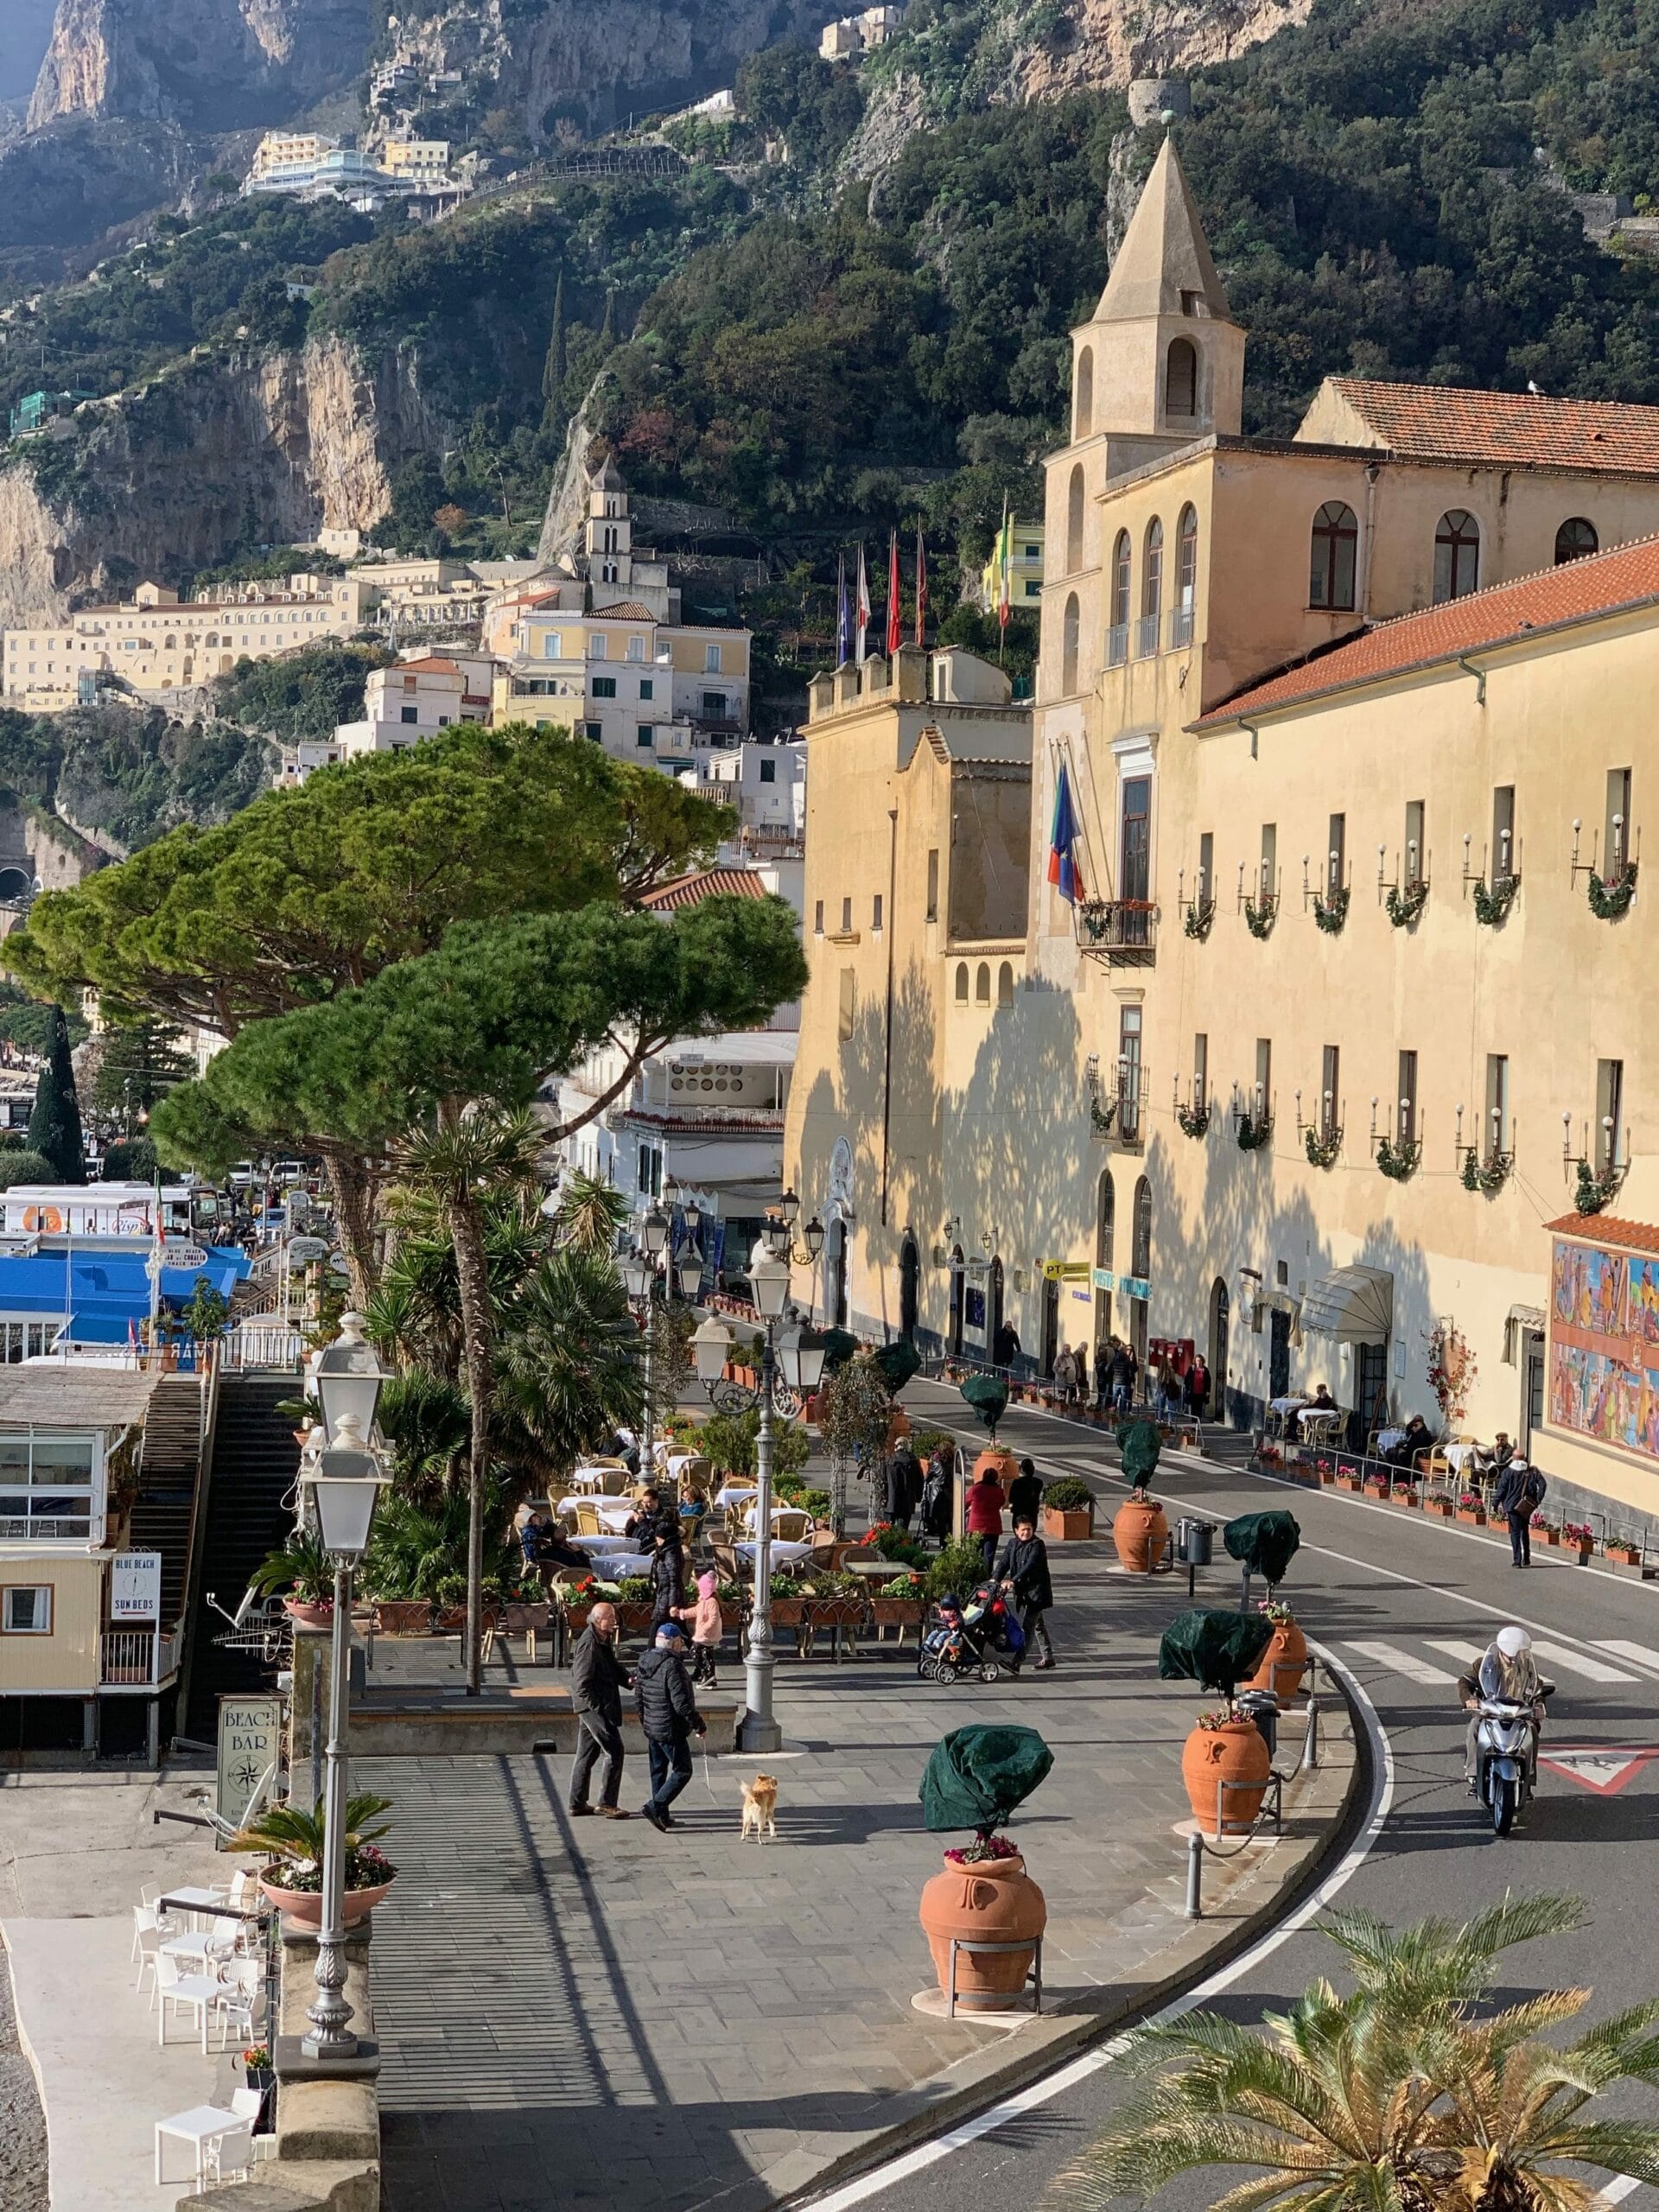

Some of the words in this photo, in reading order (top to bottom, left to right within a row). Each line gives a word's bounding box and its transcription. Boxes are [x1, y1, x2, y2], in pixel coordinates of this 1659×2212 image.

[1046, 1264, 1061, 1274] PT
[116, 1559, 132, 1569] BLUE
[134, 1559, 155, 1569] BEACH
[115, 1599, 130, 1610] SUN
[132, 1599, 153, 1610] BEDS
[225, 1712, 276, 1727] BEACH
[232, 1735, 268, 1751] BAR
